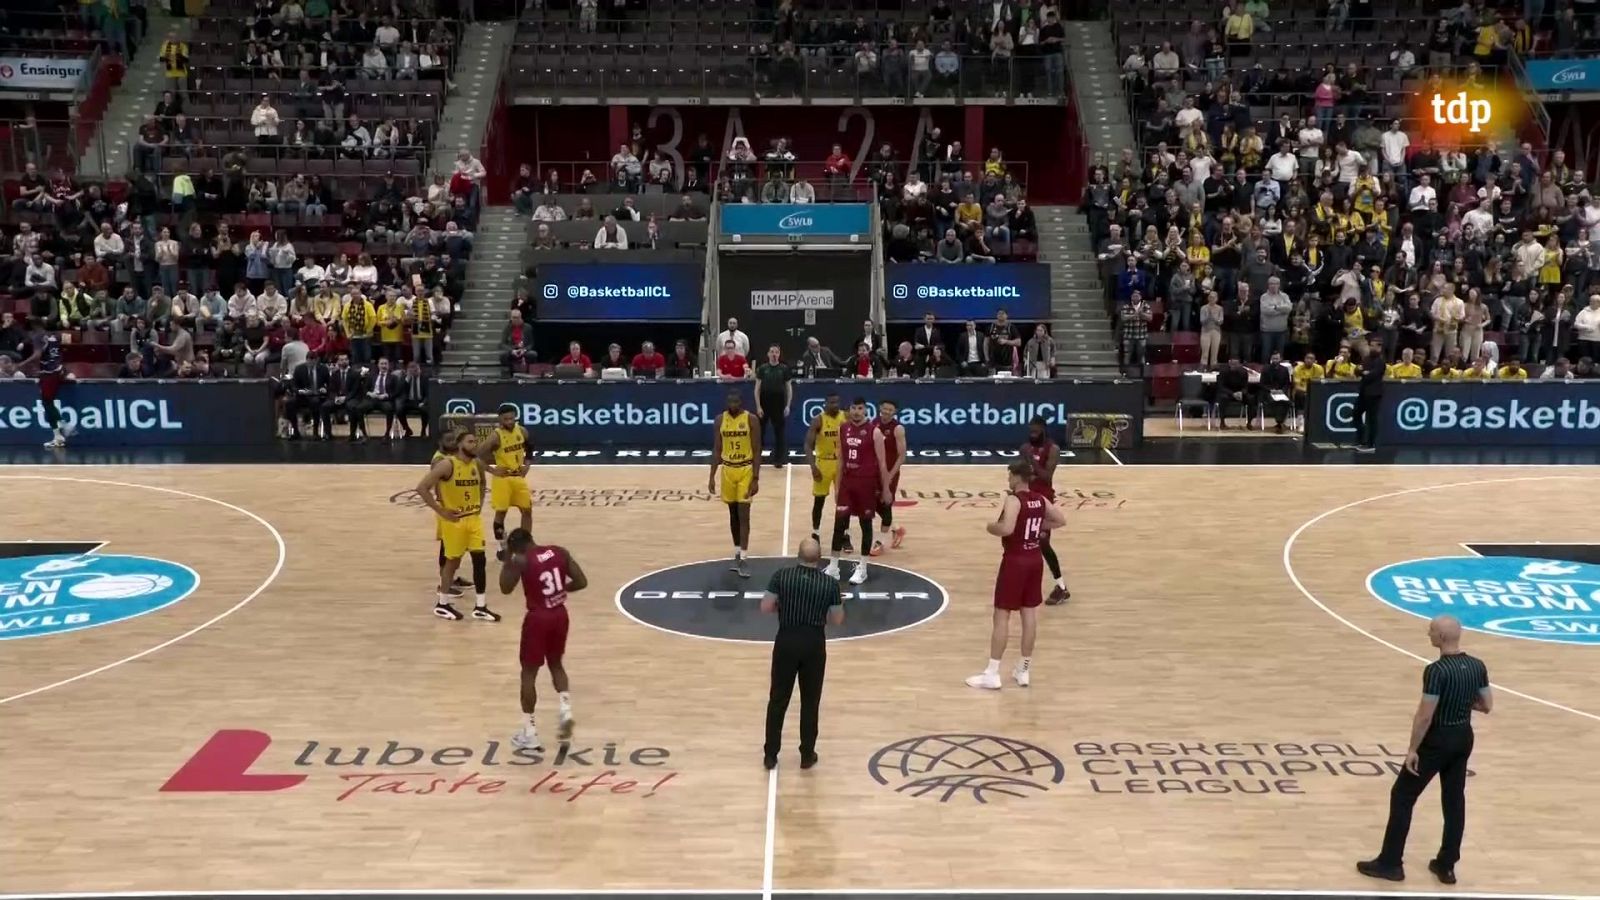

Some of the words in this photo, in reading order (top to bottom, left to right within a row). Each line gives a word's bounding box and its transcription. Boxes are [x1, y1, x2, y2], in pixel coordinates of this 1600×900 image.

[20, 62, 82, 78] Ensinger
[567, 286, 671, 298] @BasketballCL
[917, 286, 1020, 298] @BasketballCL
[464, 491, 471, 502] 5
[1024, 517, 1042, 540] 14
[539, 567, 563, 596] 31
[1391, 575, 1579, 598] RIESEN
[1397, 588, 1593, 612] STROM
[294, 740, 671, 766] lubelskie
[1073, 742, 1408, 757] BASKETBALL
[336, 772, 507, 801] Taste
[530, 770, 679, 802] life!
[1090, 778, 1306, 794] LEAGUE
